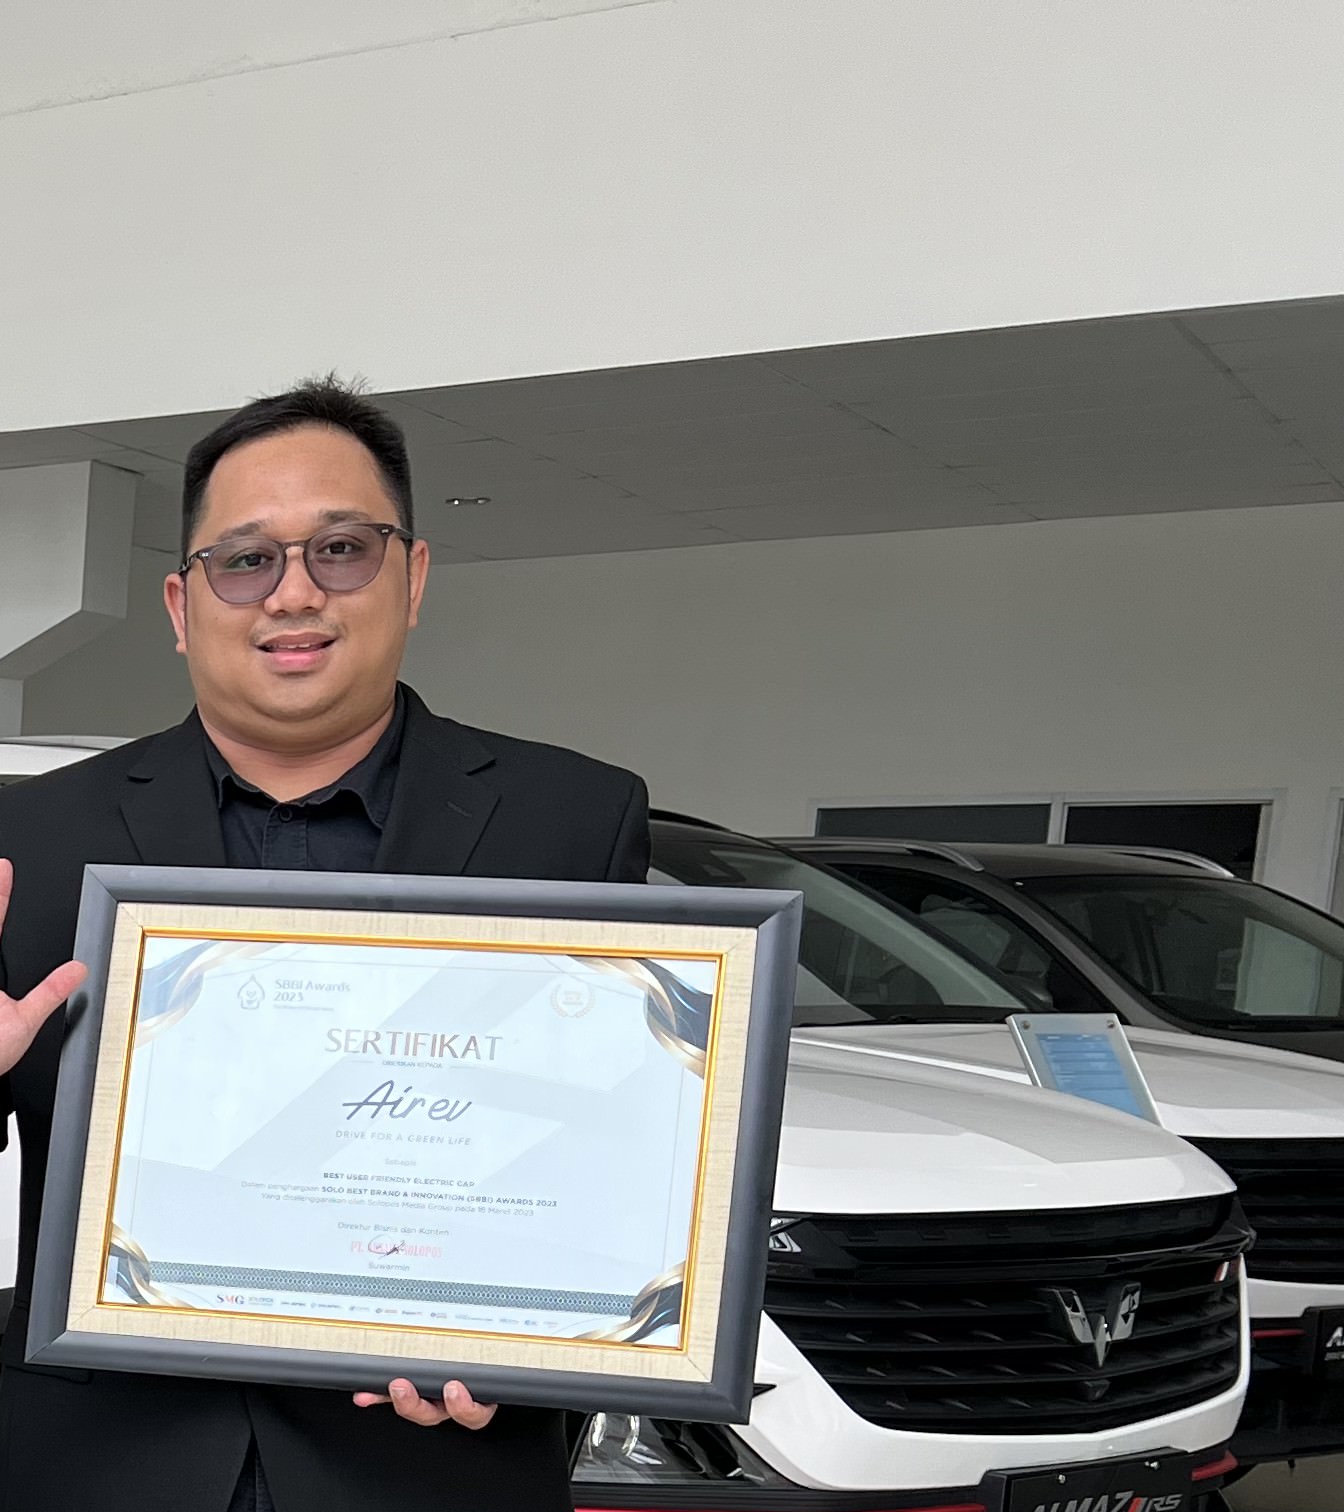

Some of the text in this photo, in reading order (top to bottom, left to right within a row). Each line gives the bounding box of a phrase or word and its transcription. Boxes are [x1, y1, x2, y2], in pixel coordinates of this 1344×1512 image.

[305, 981, 351, 993] Awards
[273, 991, 304, 1002] 2023
[324, 1028, 503, 1060] SERTIFIKAT
[370, 1132, 392, 1141] FOR
[395, 1133, 403, 1142] A
[407, 1134, 444, 1144] GREEN
[323, 1172, 344, 1180] BEST
[346, 1174, 368, 1182] USER
[370, 1175, 411, 1184] FRIENDLY
[413, 1177, 454, 1187] ELECTRIC
[321, 1186, 344, 1194] SOLO
[370, 1189, 401, 1197] BRAND
[411, 1192, 465, 1201] INNOVATION
[496, 1197, 534, 1206] AWARDS
[536, 1199, 558, 1208] 2023
[261, 1193, 280, 1201] Yang
[427, 1202, 453, 1212] Group
[454, 1204, 476, 1213] pada
[513, 1208, 534, 1216] 2023
[400, 1225, 417, 1234] dan
[216, 1294, 244, 1305] SMG
